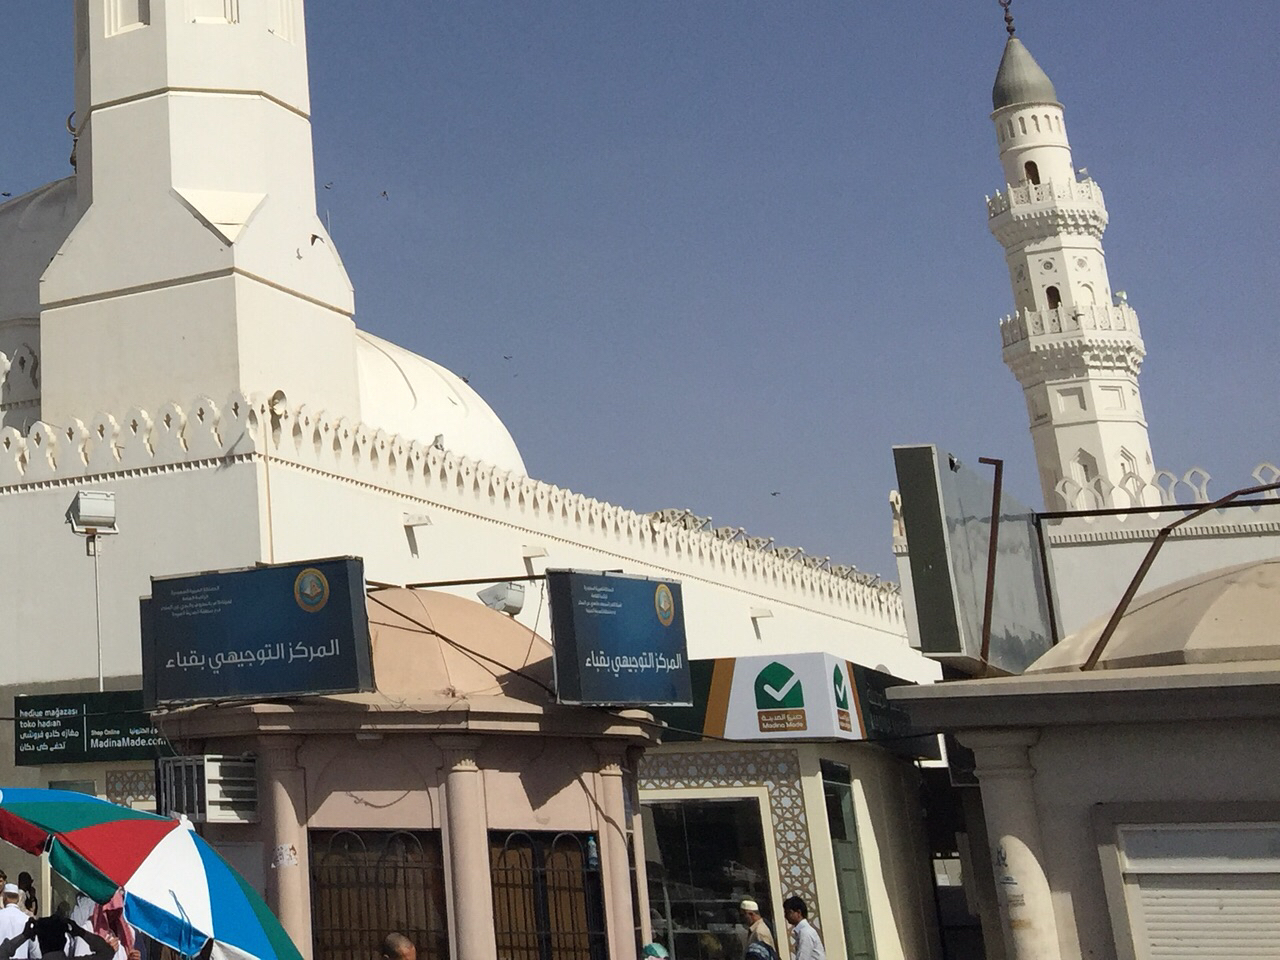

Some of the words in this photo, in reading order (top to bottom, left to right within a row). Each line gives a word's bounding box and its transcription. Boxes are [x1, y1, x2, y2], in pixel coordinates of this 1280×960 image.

[166, 650, 206, 671] بقباء
[208, 643, 286, 674] التوجيهي
[288, 639, 340, 664] المركز
[585, 650, 611, 672] بقباء
[612, 652, 655, 678] التوجيهي
[655, 653, 683, 673] المركز
[19, 720, 36, 729] toko
